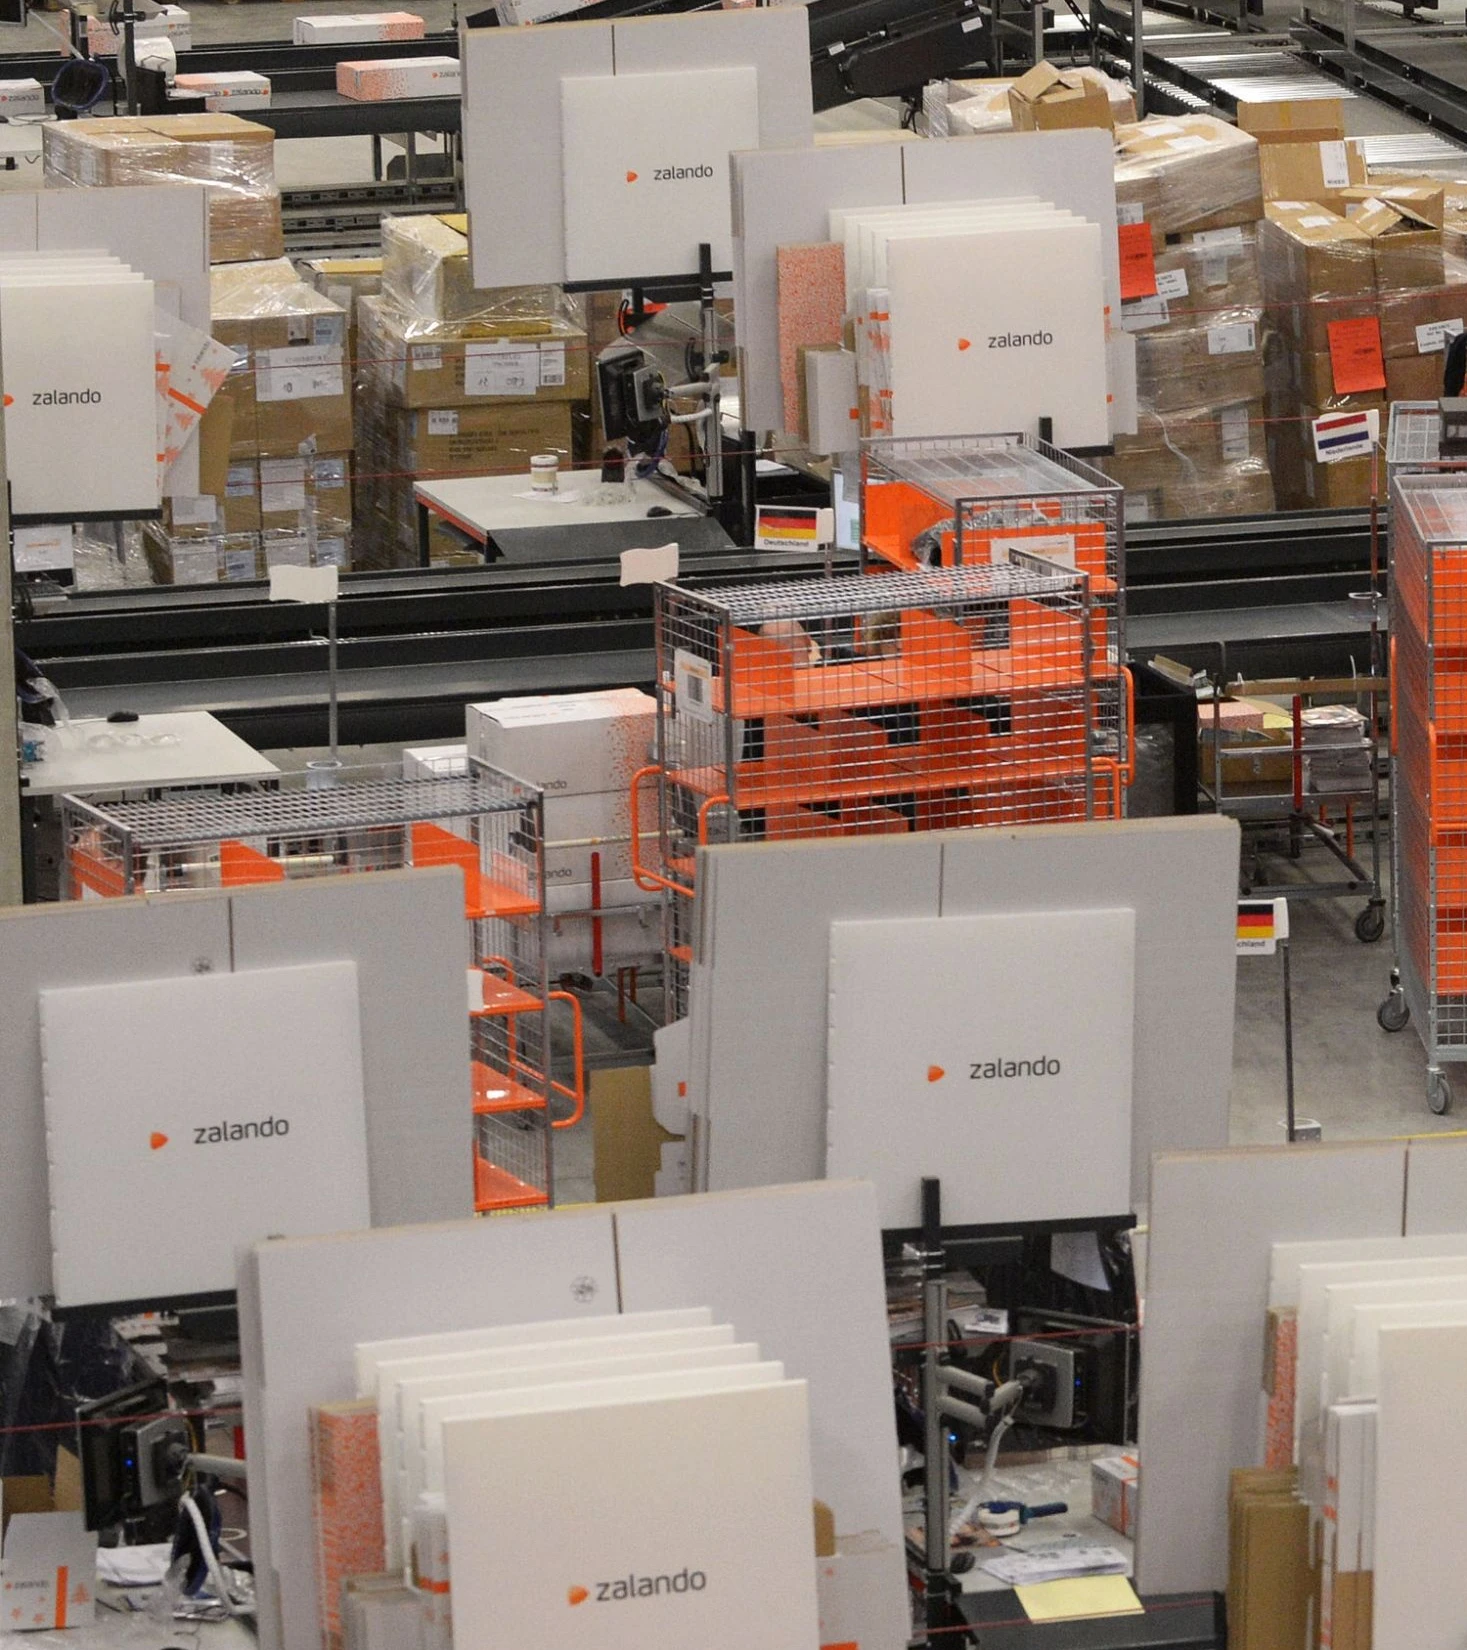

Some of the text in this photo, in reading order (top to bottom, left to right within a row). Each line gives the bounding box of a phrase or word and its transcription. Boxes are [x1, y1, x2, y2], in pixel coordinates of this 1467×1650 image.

[653, 165, 714, 181] zalando
[988, 330, 1053, 349] zalando
[32, 388, 102, 406] zalando
[1325, 443, 1364, 455] Niederlande
[763, 539, 810, 549] Deutschland
[1236, 940, 1266, 948] chland
[969, 1055, 1061, 1080] zalando
[193, 1115, 290, 1145] zalando
[595, 1567, 707, 1602] zalando
